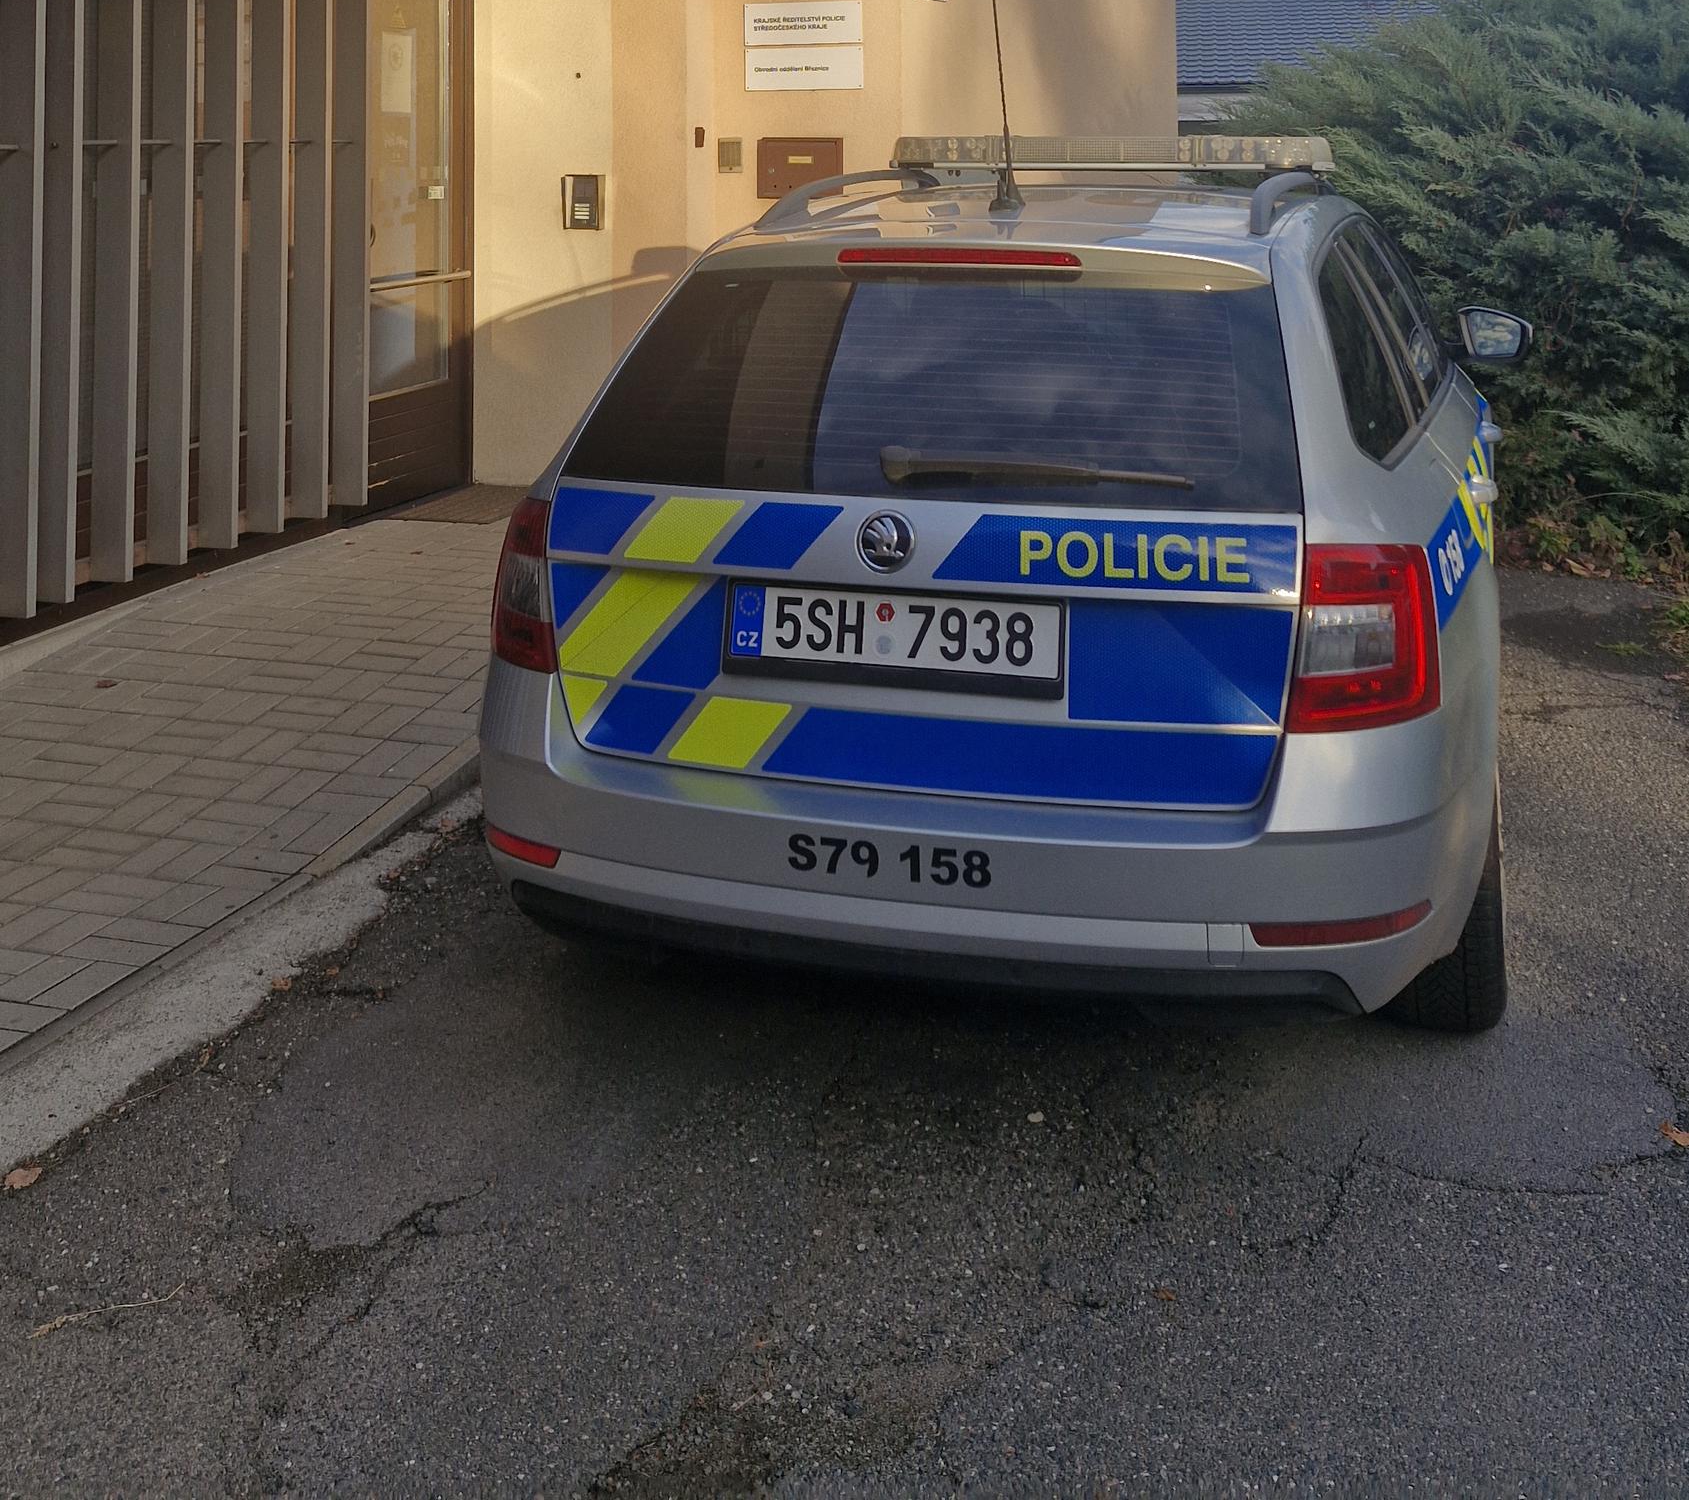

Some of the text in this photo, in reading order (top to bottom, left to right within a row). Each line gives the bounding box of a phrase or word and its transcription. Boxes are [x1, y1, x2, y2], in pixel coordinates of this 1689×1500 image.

[808, 23, 828, 31] KRAJE
[1020, 530, 1250, 584] POLICIE
[736, 596, 1034, 667] CZ 5SH 7938
[788, 833, 992, 889] S79 158
